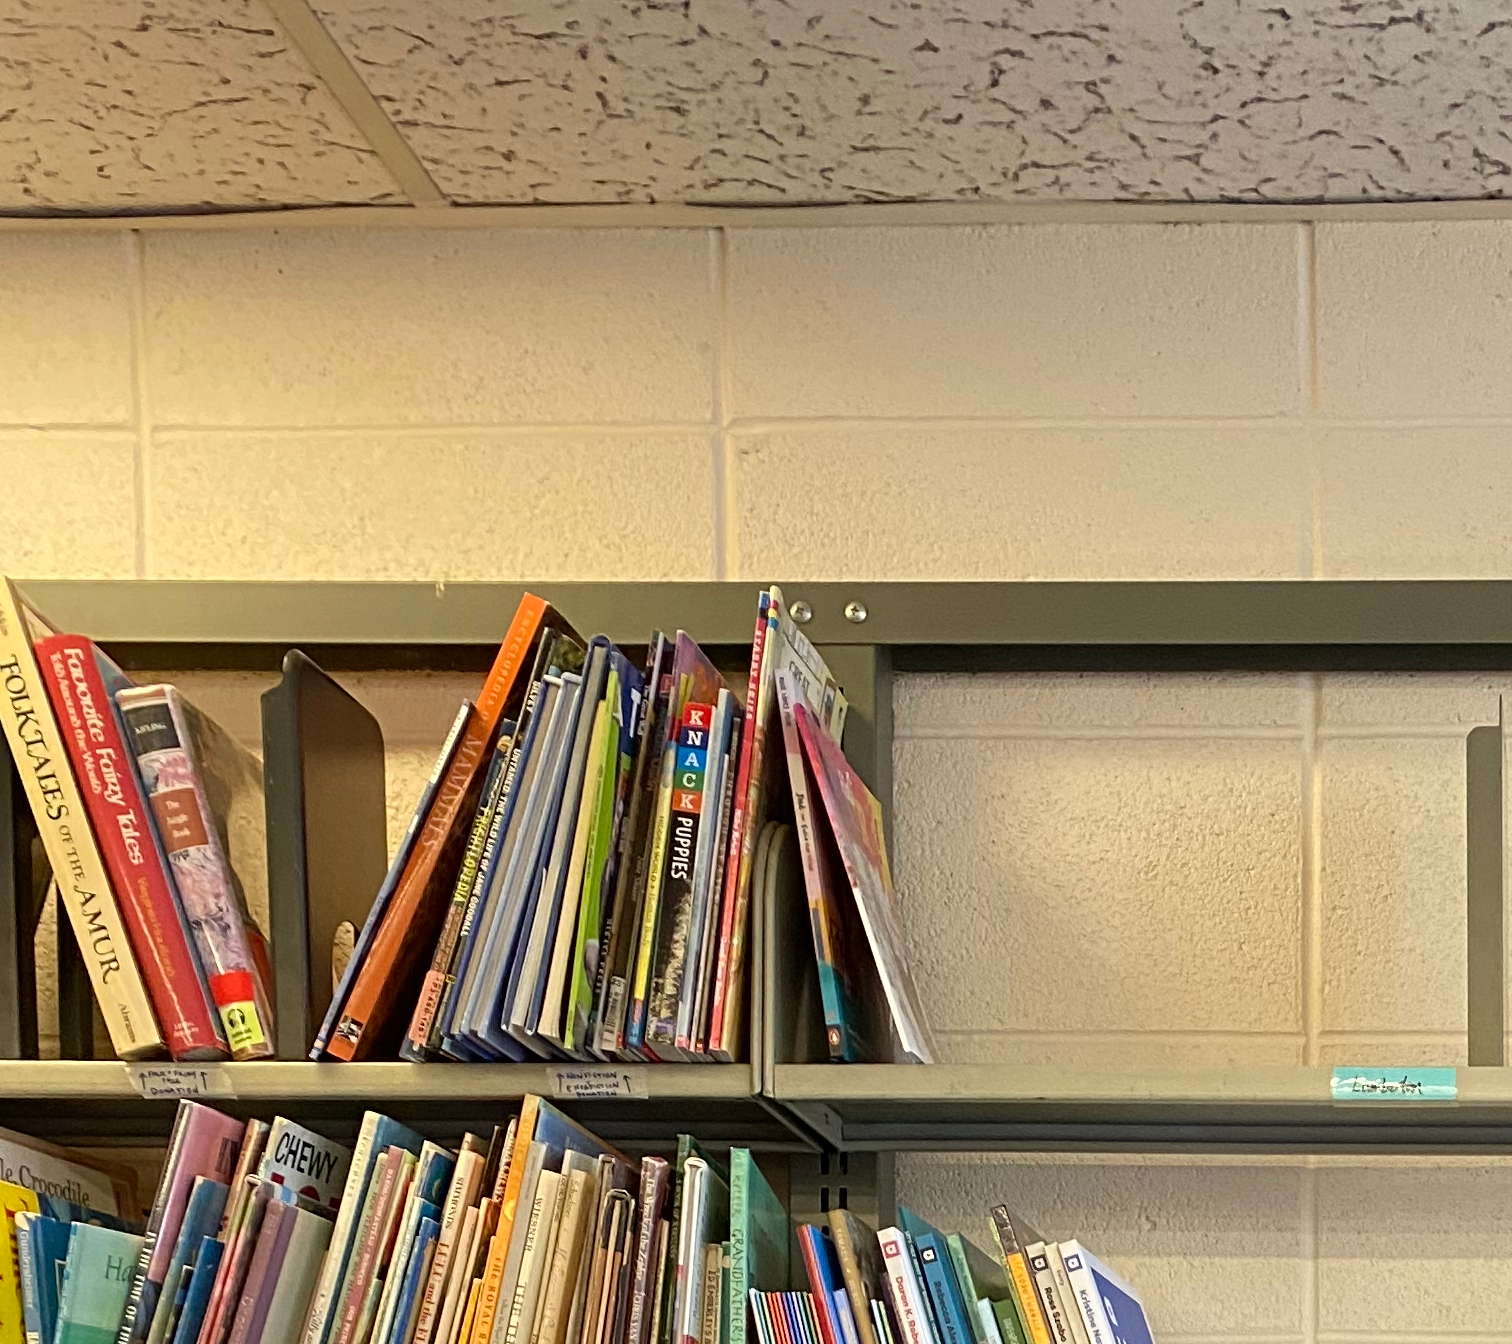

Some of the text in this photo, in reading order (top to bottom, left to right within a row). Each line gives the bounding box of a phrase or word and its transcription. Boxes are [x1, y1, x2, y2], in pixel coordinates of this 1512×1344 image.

[63, 648, 105, 742] Favorite
[95, 748, 125, 807] Fairy
[116, 808, 144, 866] Tales
[680, 709, 703, 809] KNACK
[0, 653, 123, 985] FOLKTALES OF THE AMUR
[671, 817, 694, 880] PUPPIES
[274, 1131, 339, 1183] CHEWY
[18, 1166, 91, 1208] Crocodile
[525, 1197, 543, 1252] WIESNER
[514, 1283, 527, 1317] THE
[1079, 1289, 1097, 1327] Kristine
